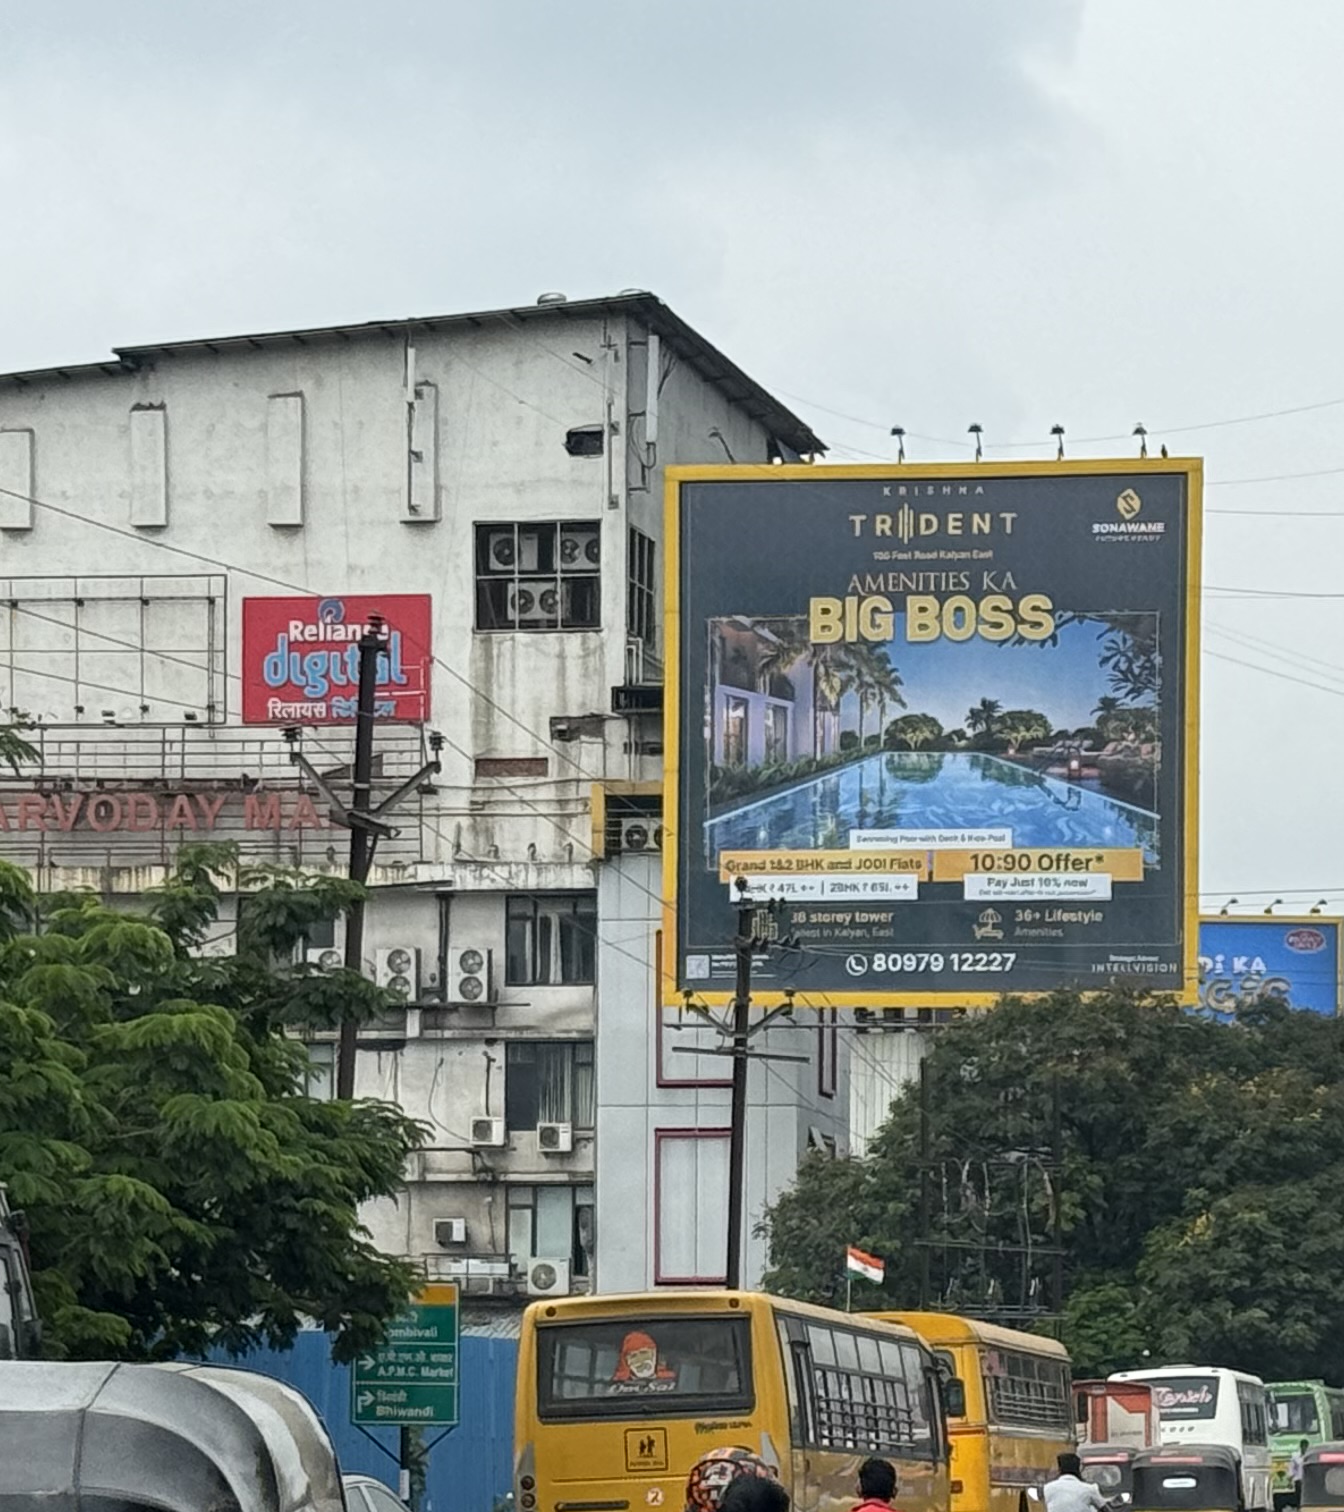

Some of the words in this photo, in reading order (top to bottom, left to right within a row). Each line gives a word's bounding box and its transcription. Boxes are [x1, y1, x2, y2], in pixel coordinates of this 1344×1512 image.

[883, 486, 984, 497] KRISHNA
[849, 503, 1017, 544] TRIDENT
[848, 571, 971, 596] AMENITIES
[982, 571, 1017, 592] KA
[810, 595, 894, 644] BIG
[906, 594, 1055, 643] BOSS
[289, 620, 389, 642] Reliane
[726, 859, 767, 873] Grand
[796, 858, 825, 872] BHK
[890, 857, 923, 871] Flats
[970, 853, 1031, 873] 10:90
[987, 877, 1008, 889] Pay
[1010, 877, 1035, 889] Just
[809, 911, 852, 926] storey
[855, 911, 894, 923] tower
[1045, 908, 1104, 924] Lifestyle
[873, 953, 944, 972] 80979
[950, 953, 1016, 972] 12227
[1233, 955, 1266, 974] KA
[386, 1326, 438, 1338] ombivali
[421, 1366, 454, 1377] Market
[376, 1405, 434, 1418] Bhiwandi
